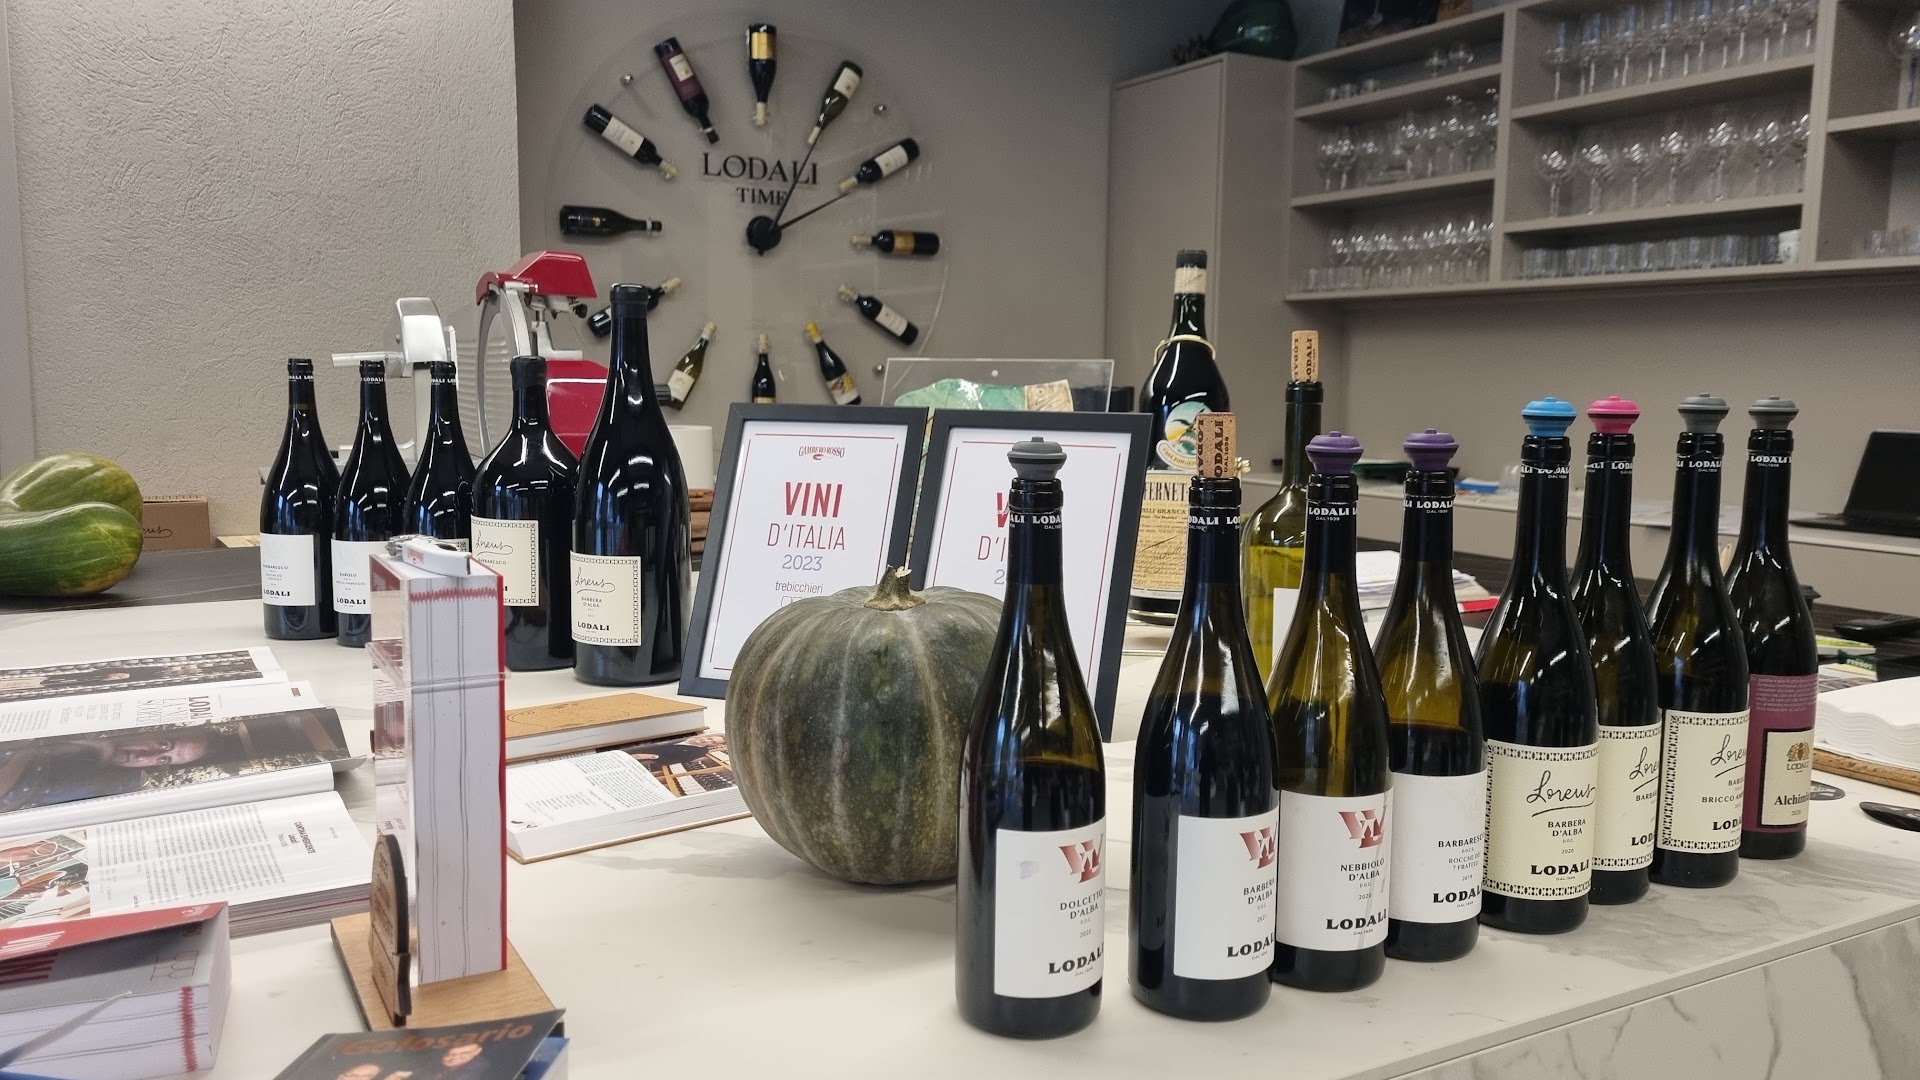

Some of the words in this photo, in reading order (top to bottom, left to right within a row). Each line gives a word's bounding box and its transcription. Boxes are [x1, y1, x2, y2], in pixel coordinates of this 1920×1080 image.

[703, 152, 818, 185] LODALI
[1750, 455, 1787, 464] LODALI
[785, 481, 843, 518] VINI
[1308, 506, 1349, 516] LODALI
[767, 522, 845, 551] D'ITALIA
[781, 553, 824, 572] 2023
[263, 588, 291, 597] LODALI
[775, 580, 824, 594] trebicchieri
[336, 597, 366, 605] LODALI
[577, 621, 610, 631] LODALI
[1701, 794, 1735, 803] BRICCO
[1547, 818, 1586, 829] BARBERA
[1552, 827, 1583, 837] D'ALBA
[1340, 857, 1385, 872] NEBBIOLO
[1448, 854, 1474, 864] ROCCHE
[1530, 858, 1590, 876] LODALI
[1348, 870, 1380, 882] D'ALBA
[1060, 888, 1103, 911] DOLCETTO
[1070, 902, 1099, 920] D'ALBA
[1325, 907, 1387, 930] LODALI
